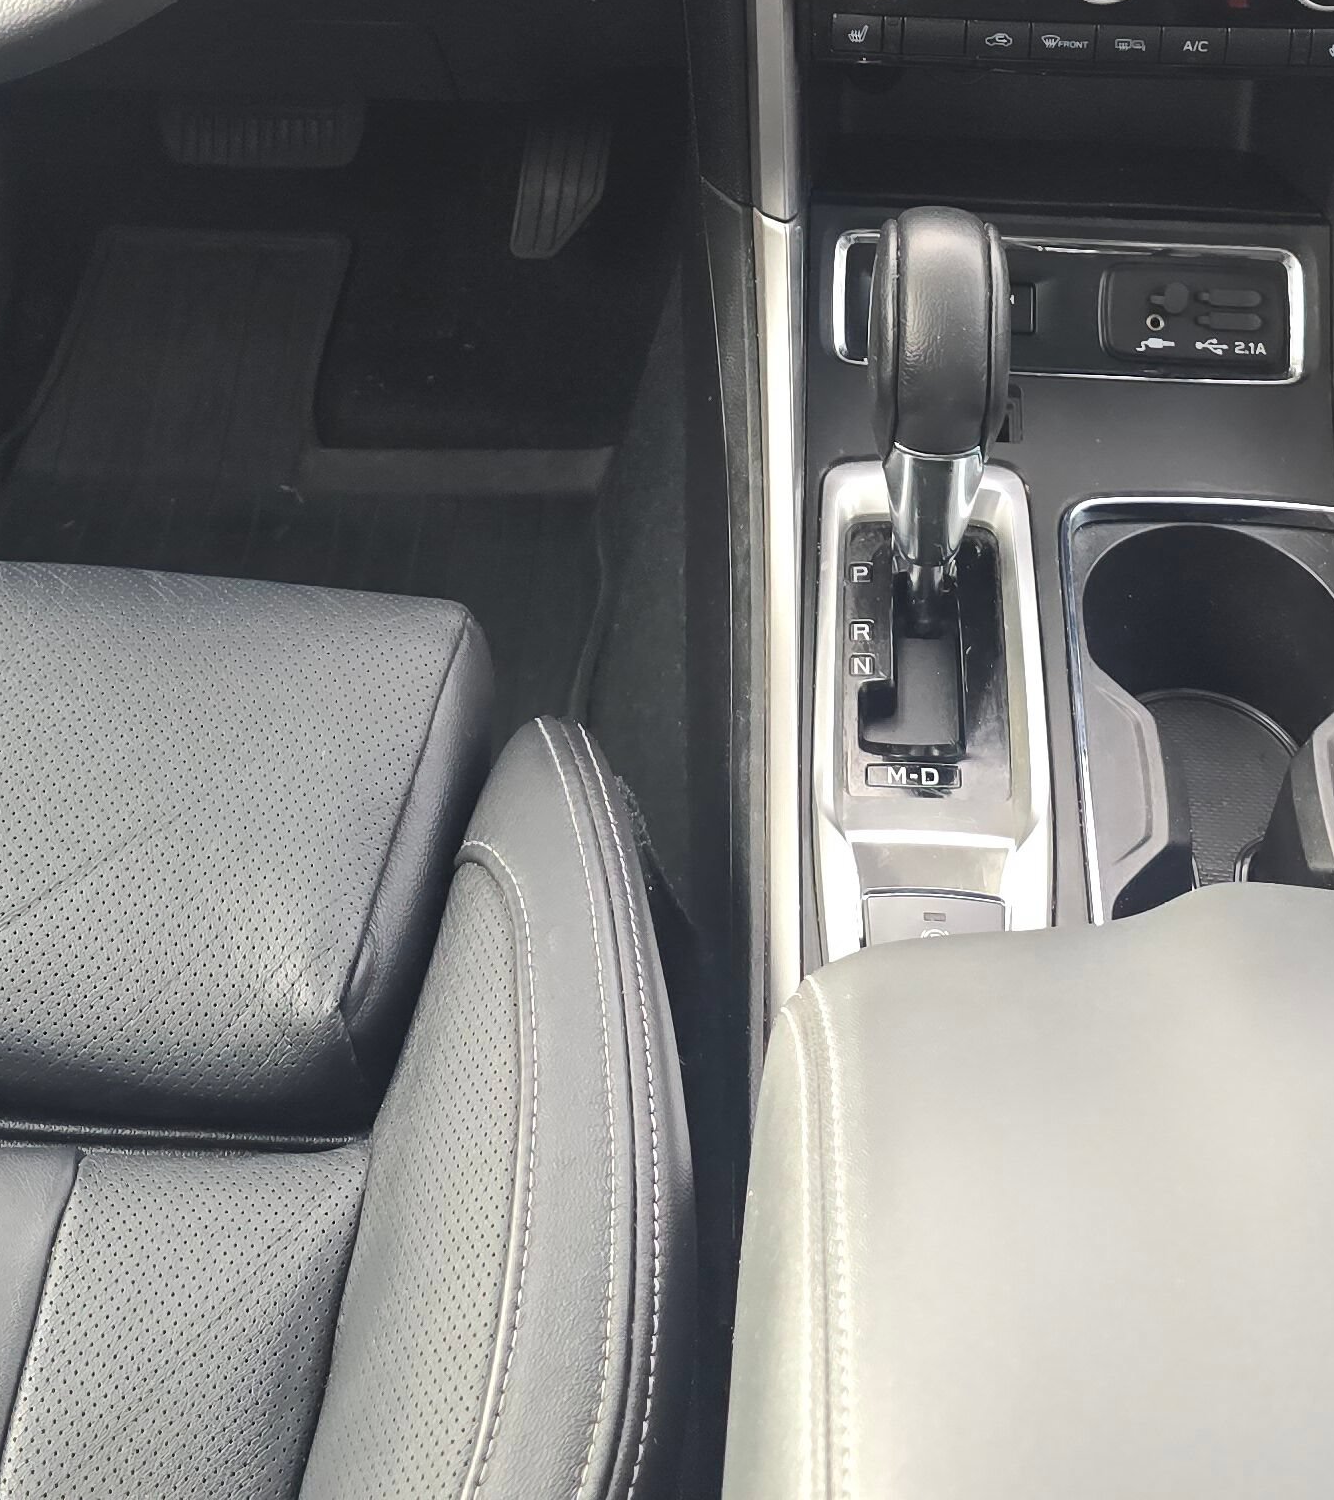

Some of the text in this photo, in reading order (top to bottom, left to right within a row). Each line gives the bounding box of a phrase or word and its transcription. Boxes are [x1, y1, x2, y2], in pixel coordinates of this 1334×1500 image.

[1058, 40, 1089, 49] FRONT
[1183, 40, 1209, 53] A/C
[1234, 341, 1267, 355] 2.1A
[853, 566, 868, 582] P
[853, 623, 869, 641] R
[853, 657, 869, 675] N
[887, 766, 940, 786] M-D
